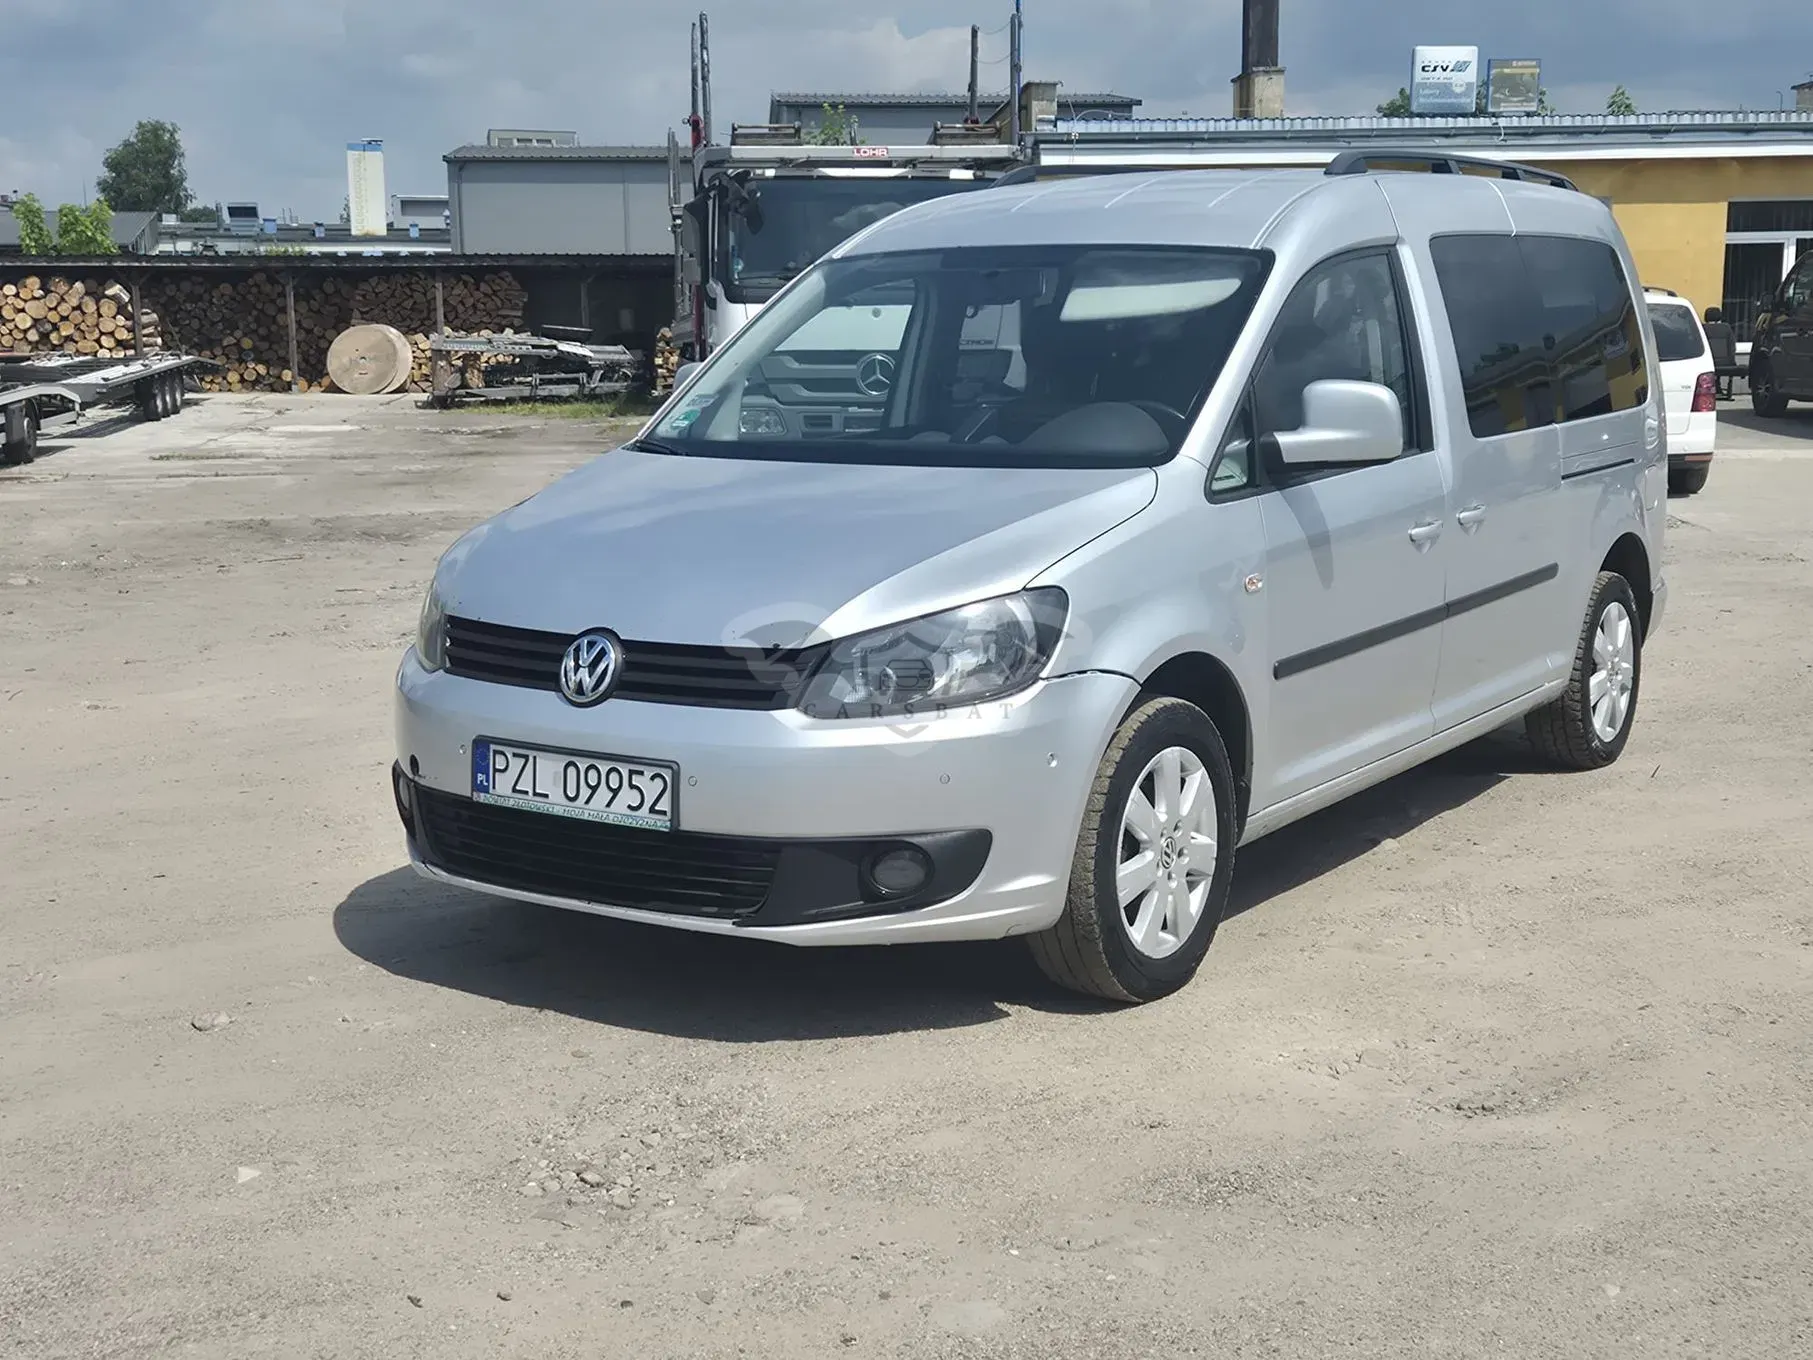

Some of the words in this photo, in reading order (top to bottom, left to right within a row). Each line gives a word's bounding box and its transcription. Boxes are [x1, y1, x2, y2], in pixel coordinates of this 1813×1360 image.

[1421, 64, 1451, 73] CSV
[854, 148, 887, 157] LOHR
[477, 774, 488, 786] PL
[492, 749, 550, 799] PZL
[563, 760, 669, 817] 09952
